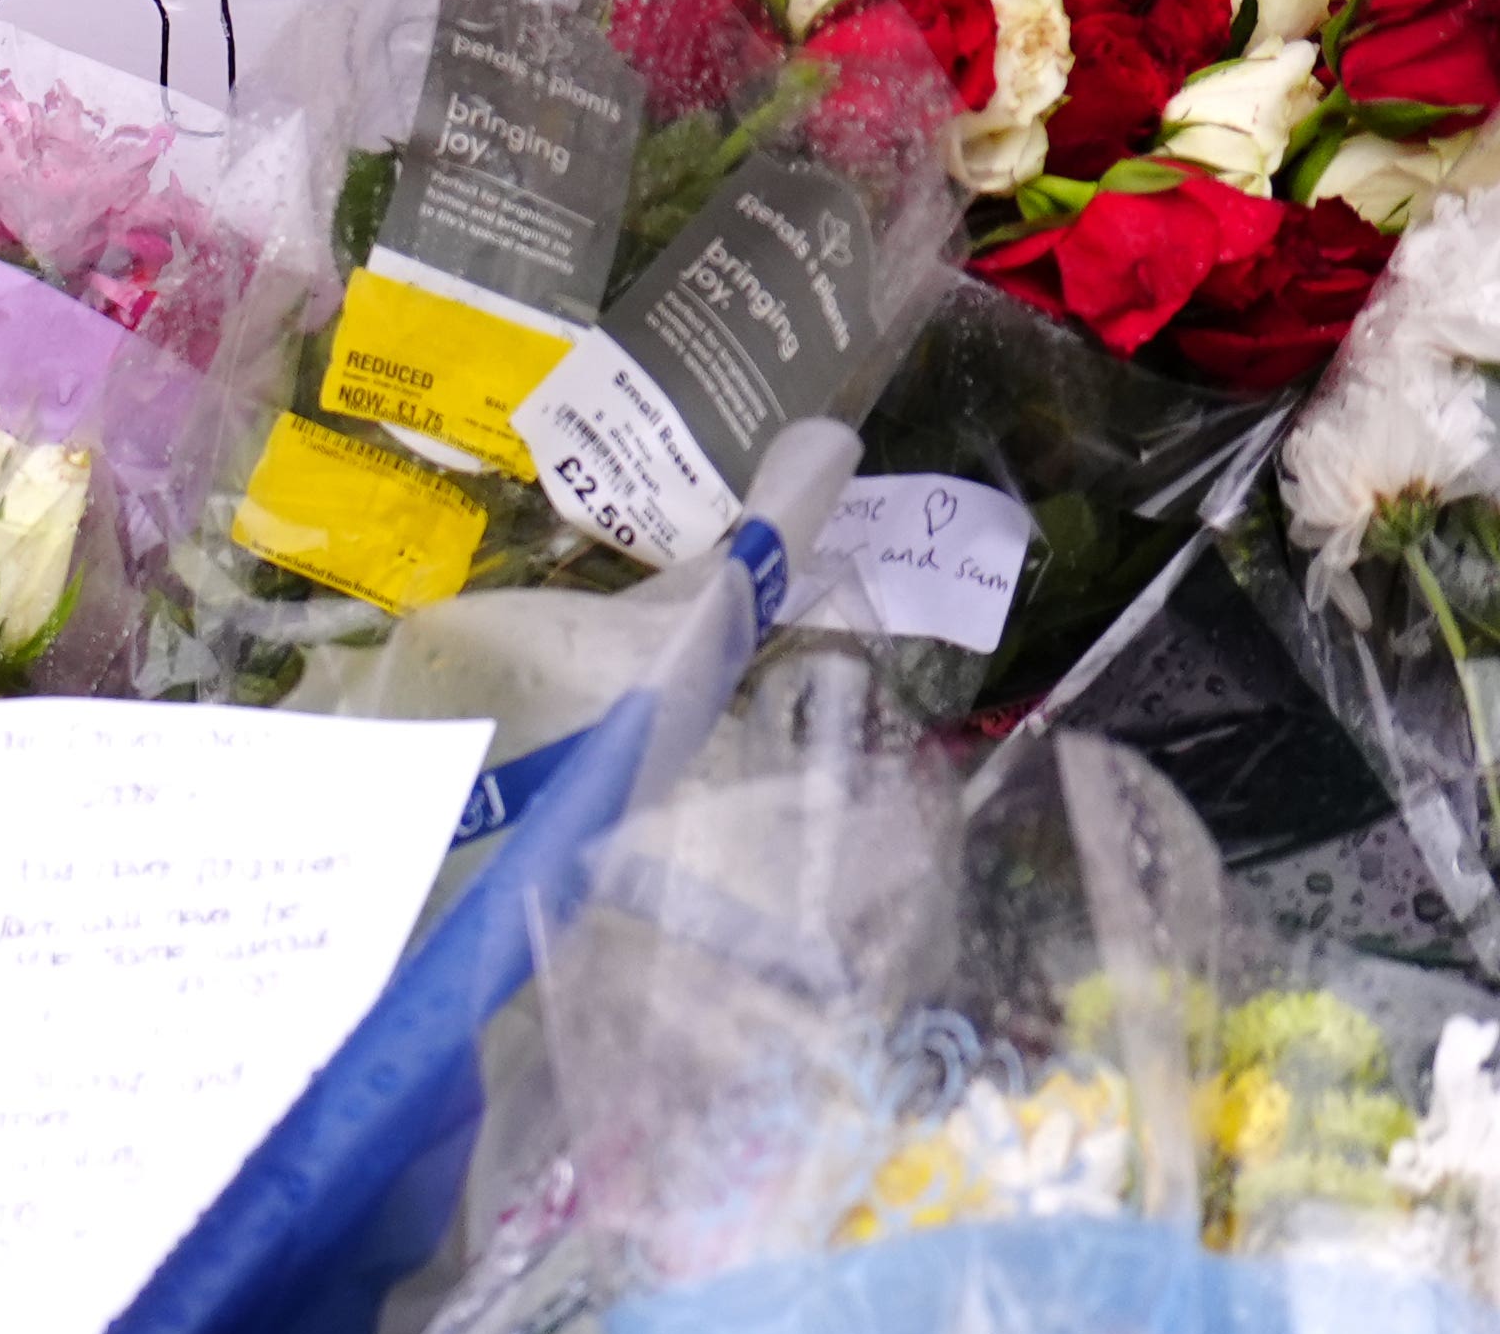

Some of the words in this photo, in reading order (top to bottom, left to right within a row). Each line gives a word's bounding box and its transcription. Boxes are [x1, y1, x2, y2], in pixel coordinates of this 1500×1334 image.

[451, 33, 529, 79] petals
[549, 75, 622, 123] plants
[450, 92, 571, 174] bringing
[704, 236, 800, 362] bringing
[736, 192, 810, 260] petals
[810, 272, 851, 353] plants
[347, 350, 434, 389] REDUCED
[613, 369, 664, 429] Small
[659, 424, 699, 487] Roses
[554, 456, 637, 547] £2.50
[880, 548, 939, 569] and
